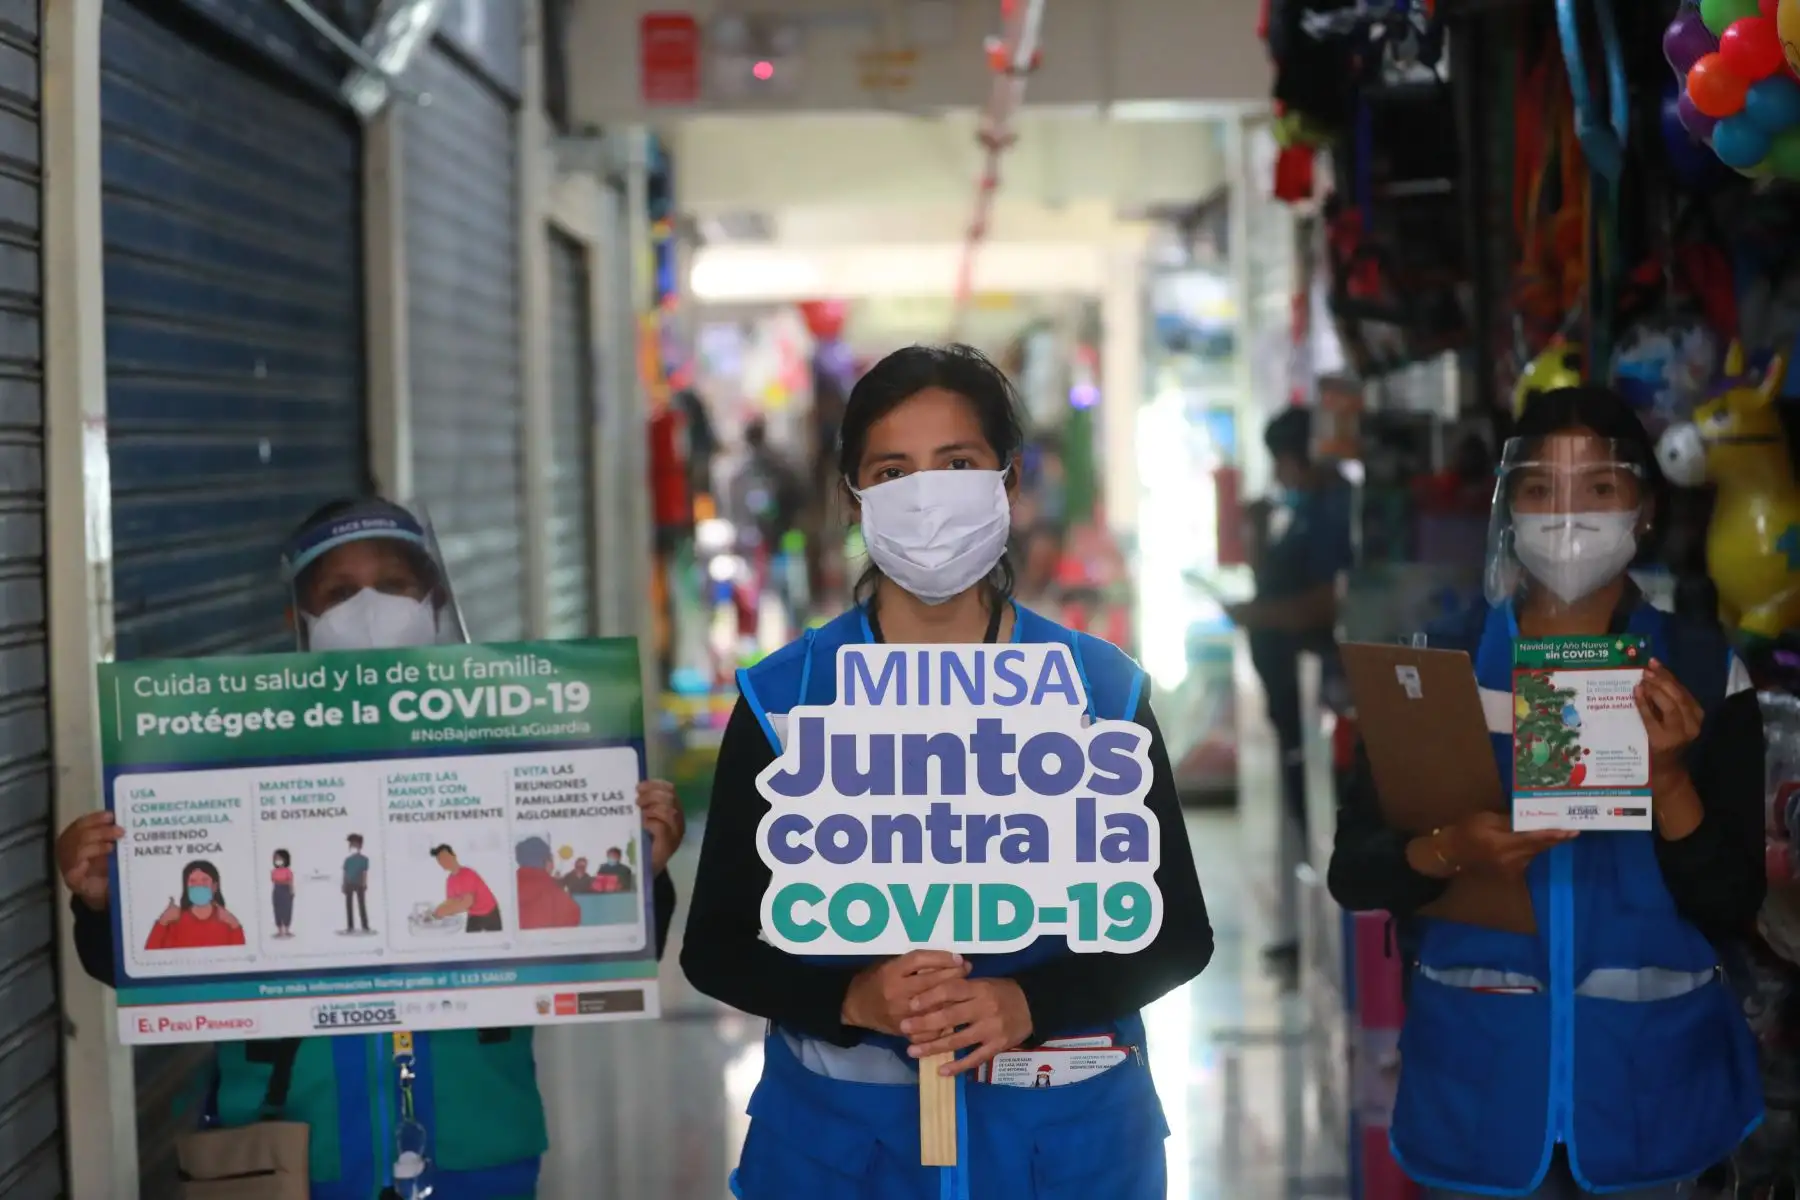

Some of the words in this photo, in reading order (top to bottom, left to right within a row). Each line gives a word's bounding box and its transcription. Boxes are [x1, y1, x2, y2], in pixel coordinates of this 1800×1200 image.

[1519, 642, 1554, 652] Navidad
[1556, 643, 1561, 651] y
[1562, 641, 1580, 650] Año
[1581, 641, 1609, 649] Nuevo
[1545, 650, 1561, 660] sin
[1562, 650, 1609, 659] COVID-19
[134, 673, 211, 697] Cuida
[219, 674, 247, 693] tu
[254, 666, 326, 692] salud
[333, 670, 349, 692] y
[356, 664, 379, 686] la
[386, 662, 420, 684] de
[427, 663, 455, 682] tu
[462, 655, 559, 680] familia.
[843, 649, 1080, 707] MINSA
[137, 708, 296, 737] Protégete
[304, 703, 343, 727] de
[352, 700, 380, 725] la
[388, 681, 592, 723] COVID-19
[411, 721, 591, 742] #NoBajemosLaGuardia
[767, 717, 1143, 797] Juntos
[436, 770, 459, 782] LAS
[514, 766, 549, 777] EVITA
[552, 764, 575, 775] LAS
[388, 784, 435, 796] MANOS
[438, 783, 468, 794] CON
[515, 778, 588, 792] REUNIONES
[130, 788, 156, 800] USA
[260, 795, 276, 807] DE
[280, 795, 287, 805] 1
[291, 792, 336, 804] METRO
[515, 792, 589, 806] FAMILIARES
[591, 792, 599, 802] Y
[602, 790, 626, 802] LAS
[131, 797, 242, 814] CORRECTAMENTE
[389, 798, 425, 809] AGUA
[428, 797, 435, 807] Y
[132, 816, 148, 828] LA
[150, 813, 233, 827] MASCARILLA,
[261, 809, 278, 821] DE
[281, 806, 348, 820] DISTANCIA
[389, 807, 505, 823] FRECUENTEMENTE
[516, 805, 635, 821] AGLOMERACIONES
[133, 828, 209, 842] CUBRIENDO
[767, 802, 1050, 865] contra
[1076, 797, 1150, 864] la
[134, 844, 172, 857] NARIZ
[176, 844, 184, 854] Y
[186, 842, 223, 854] BOCA
[771, 881, 1153, 943] COVID-19
[318, 1011, 338, 1024] DE
[342, 1008, 397, 1023] TODOS
